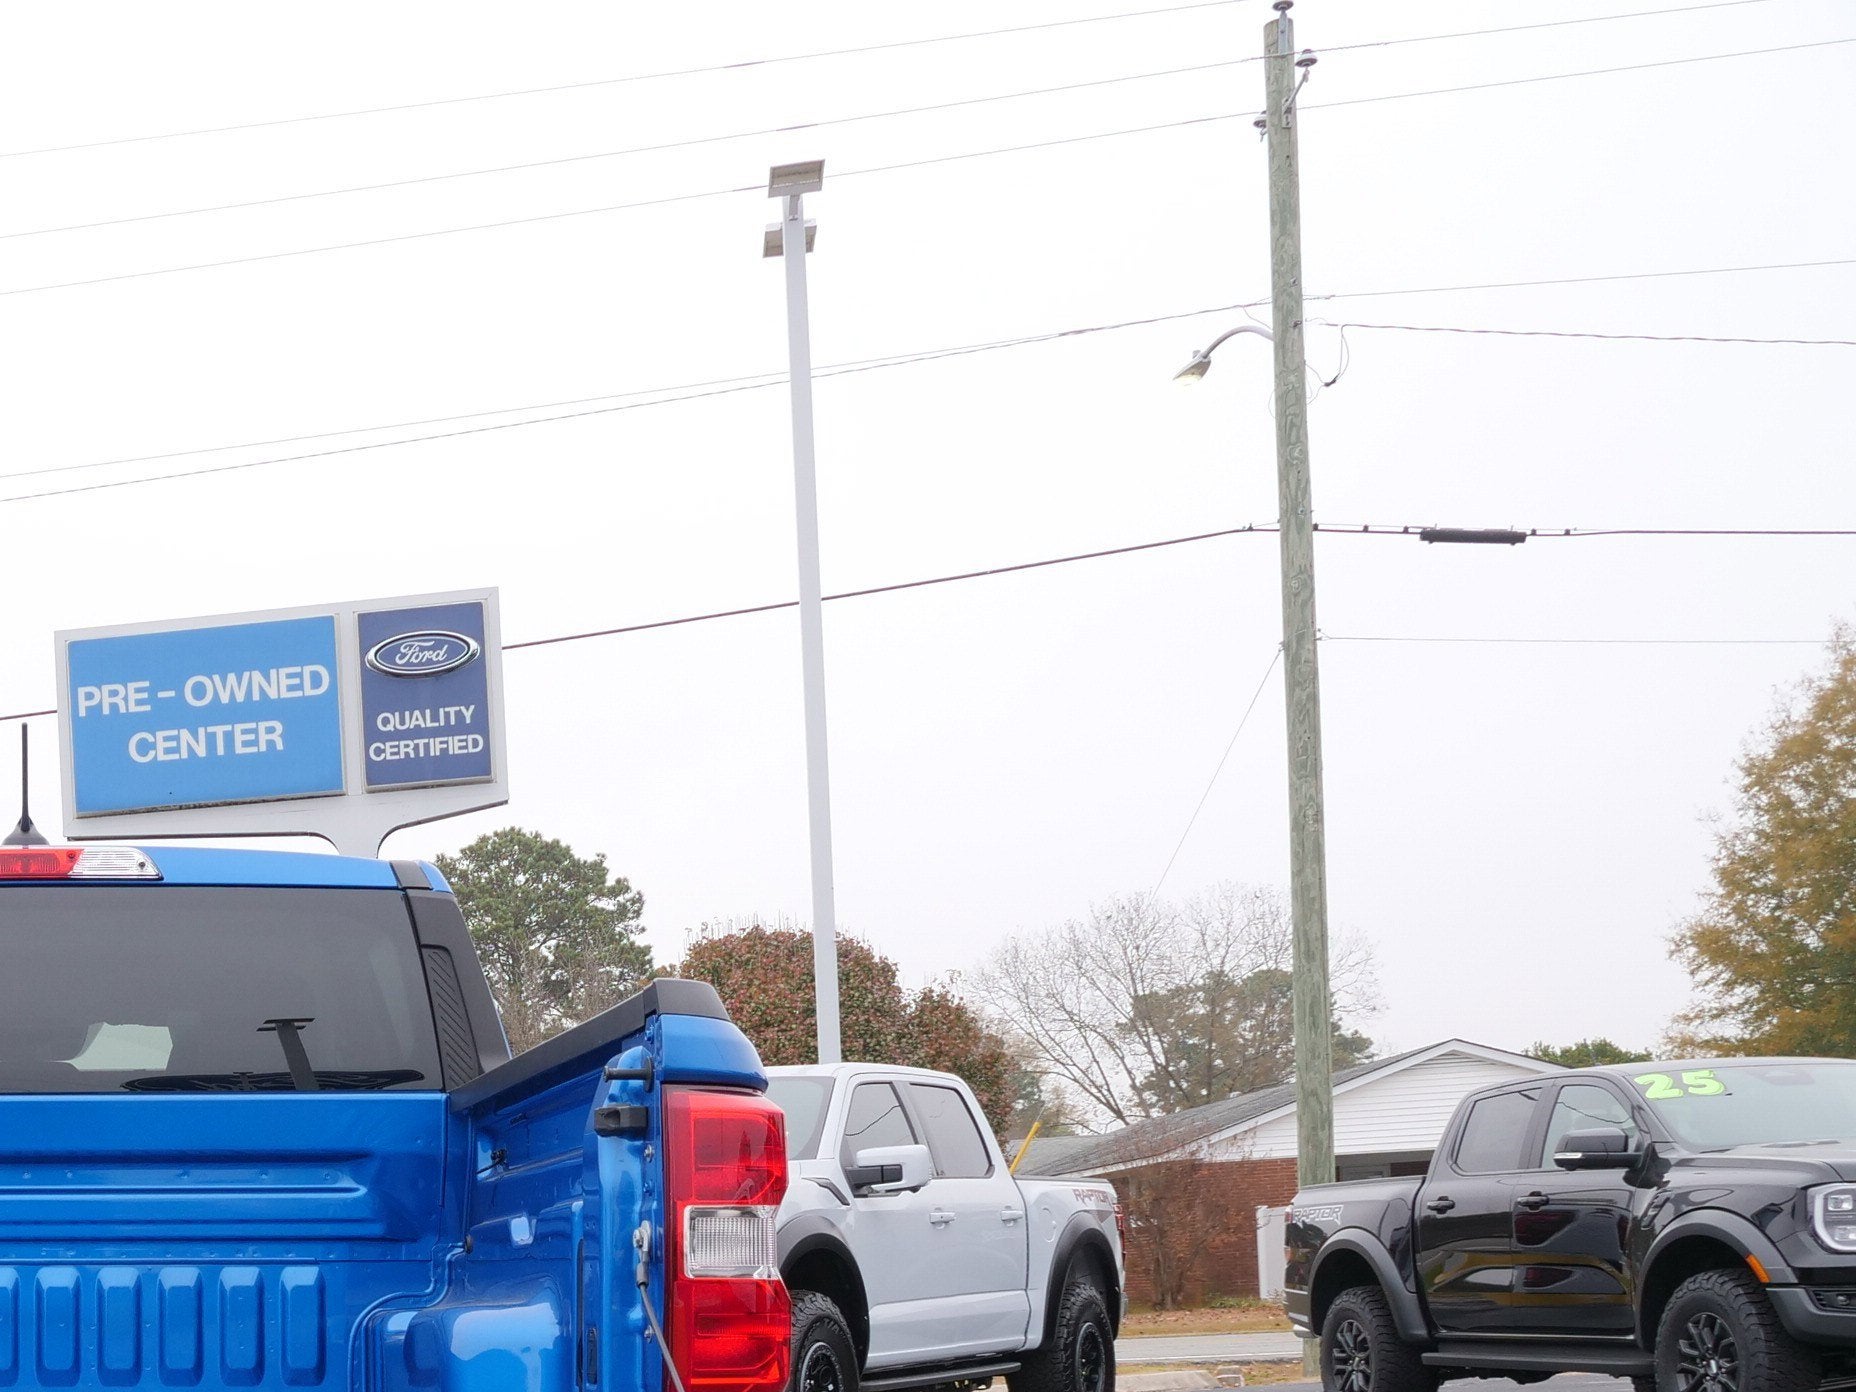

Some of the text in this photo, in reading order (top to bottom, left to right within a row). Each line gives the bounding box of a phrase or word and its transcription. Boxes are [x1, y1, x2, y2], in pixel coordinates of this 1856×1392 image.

[395, 640, 449, 665] Ford
[376, 705, 475, 732] QUALITY
[128, 720, 284, 763] CENTER
[368, 733, 484, 762] CERTIFIED
[1634, 1069, 1726, 1100] 25
[1072, 1188, 1111, 1206] RAPTOR
[1293, 1204, 1344, 1229] RAPTOR
